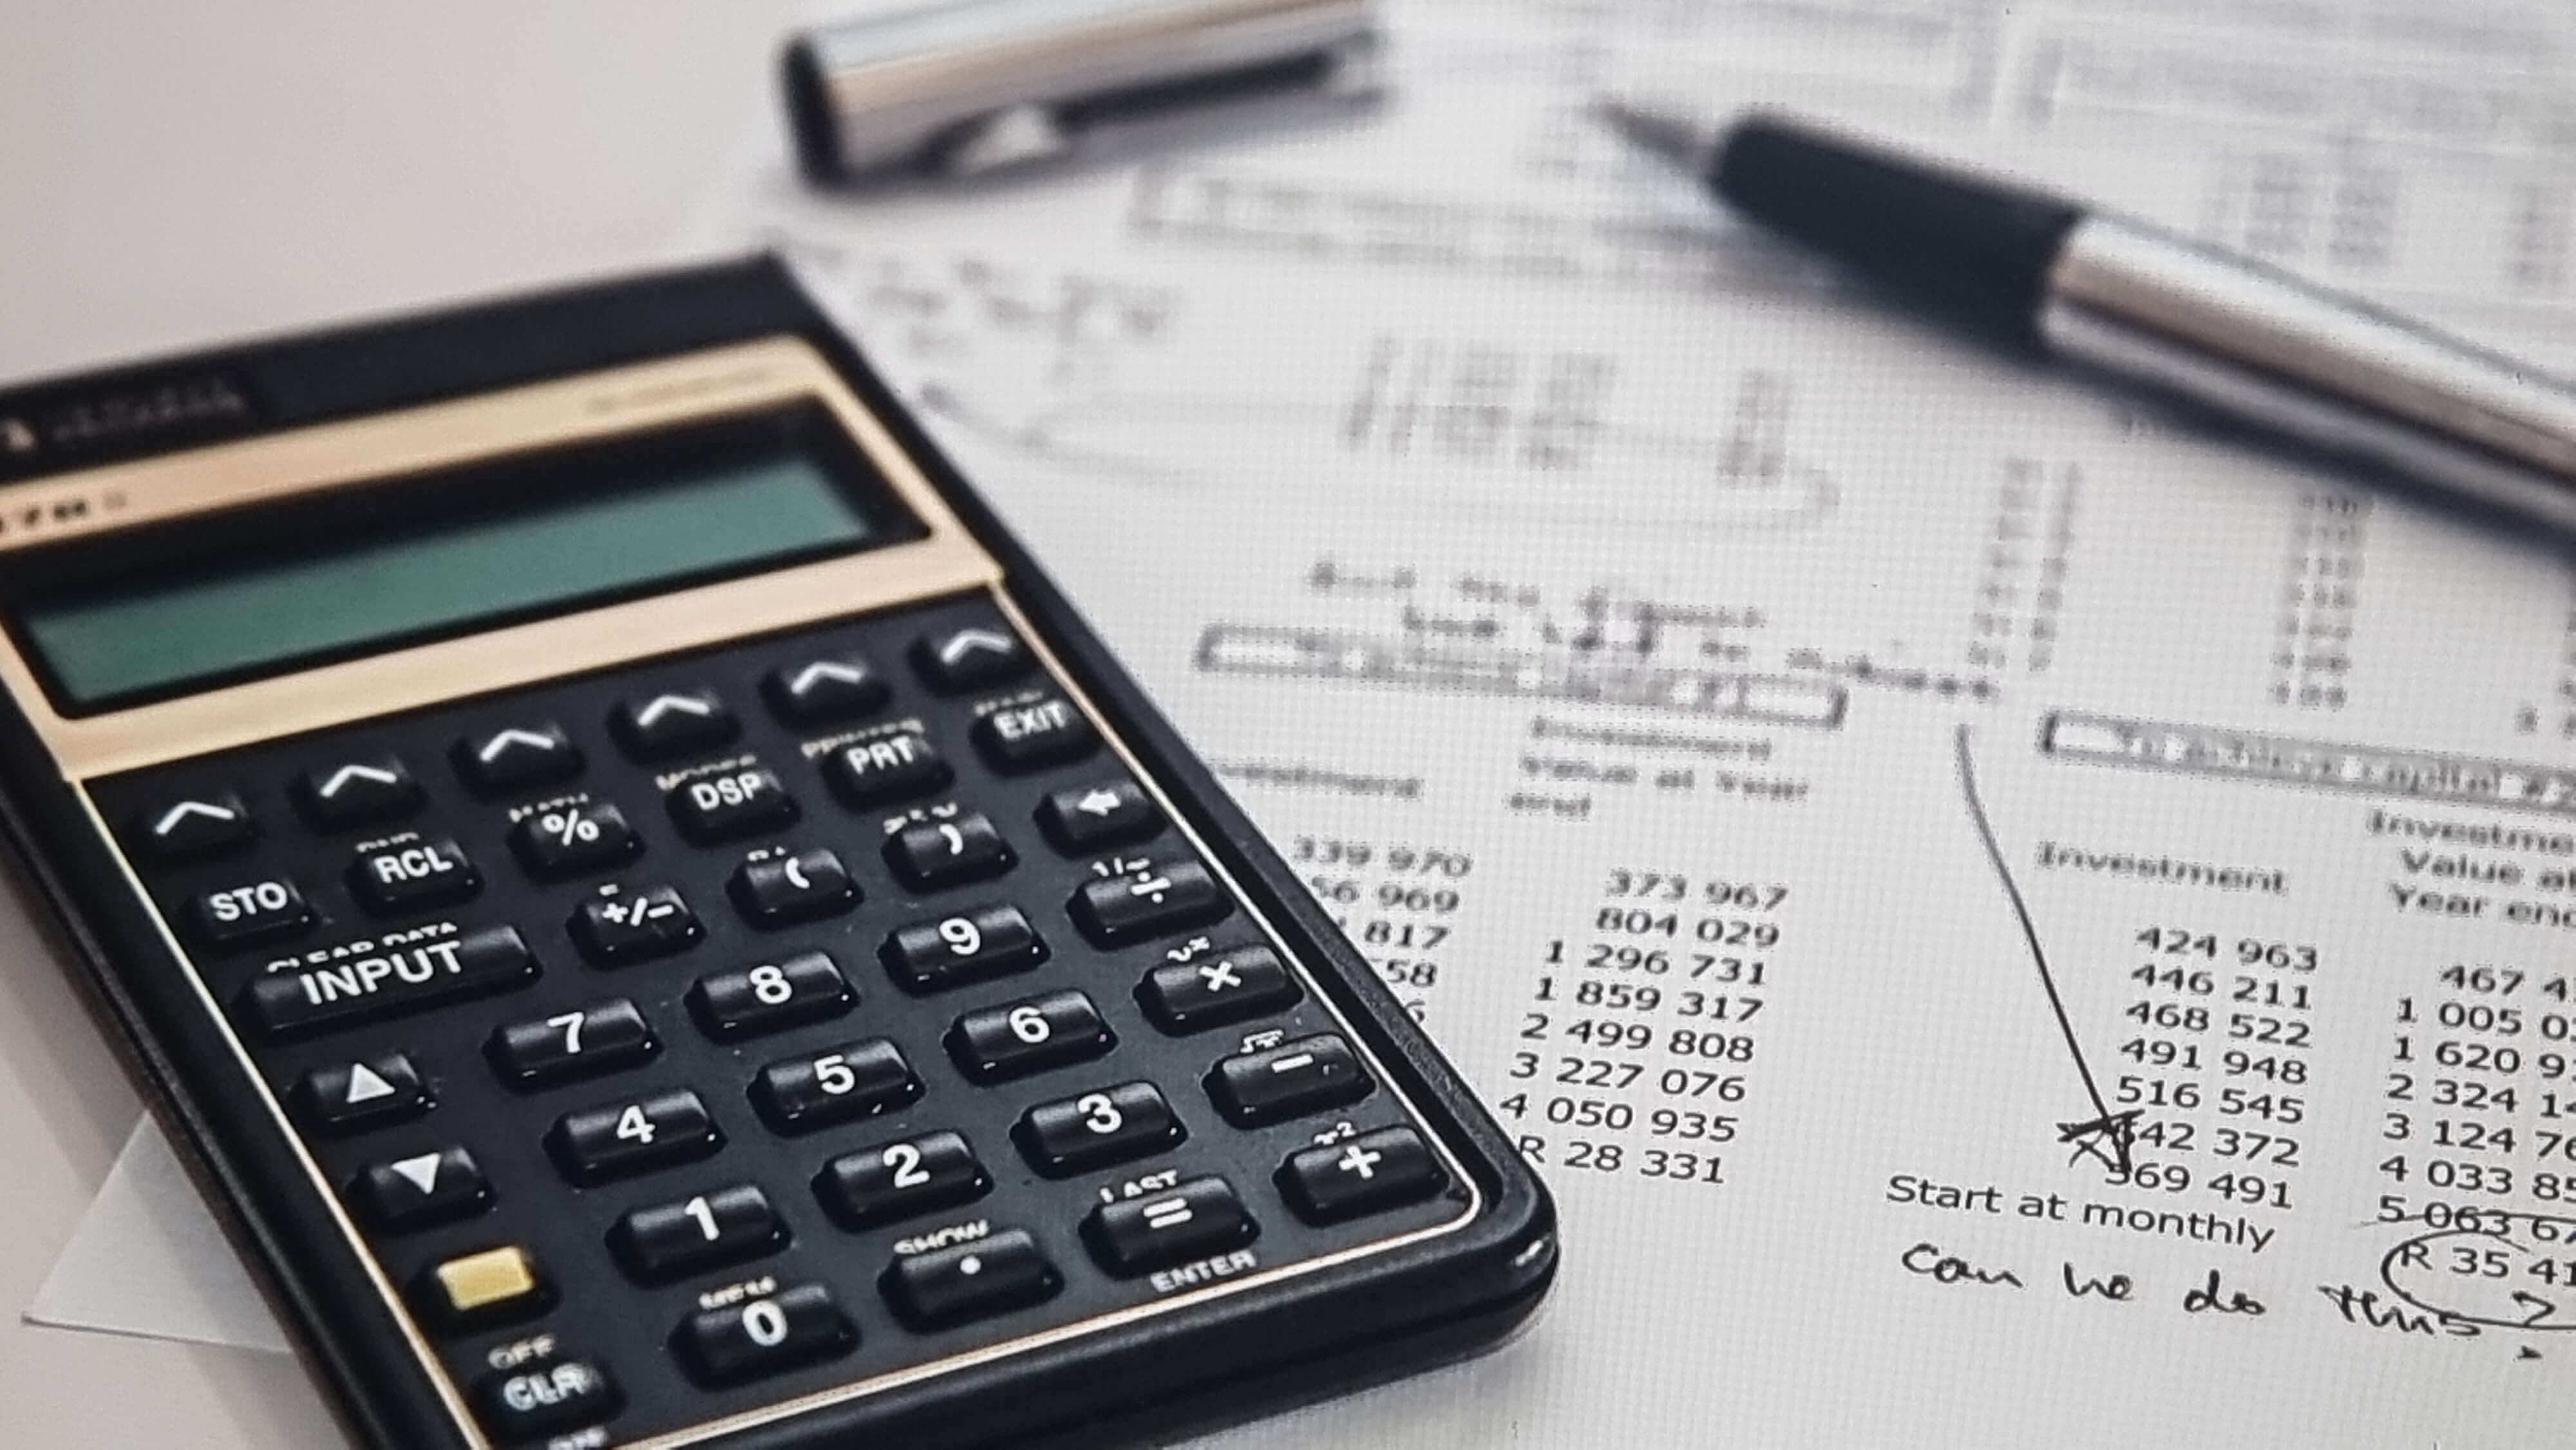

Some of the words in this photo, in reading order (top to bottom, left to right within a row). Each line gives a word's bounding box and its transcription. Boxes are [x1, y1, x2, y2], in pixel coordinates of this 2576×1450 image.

[993, 701, 1066, 739] EXIT
[846, 735, 914, 774] PRT
[690, 773, 762, 811] DSP
[374, 846, 453, 883] RCL
[2401, 847, 2523, 885] Value
[210, 883, 287, 921] STO
[1606, 869, 1688, 901] 373
[1705, 881, 1788, 911] 967
[2389, 880, 2487, 918] Year
[940, 918, 981, 955] 9
[1365, 921, 1450, 950] 817
[1596, 907, 1678, 938] 804
[1696, 918, 1780, 948] 029
[1546, 940, 1564, 964] 1
[1584, 944, 1671, 975] 296
[1689, 954, 1766, 986] 731
[2137, 927, 2217, 959] 424
[2237, 939, 2317, 972] 963
[299, 940, 461, 1004] INPUT
[749, 965, 793, 1004] 8
[1370, 957, 1438, 988] 58
[2131, 964, 2214, 995] 446
[2233, 976, 2312, 1010] 211
[2441, 965, 2524, 995] 467
[2542, 977, 2576, 1003] 4
[1535, 976, 1557, 1001] 1
[1576, 981, 1662, 1012] 859
[1678, 991, 1765, 1023] 317
[2398, 997, 2418, 1023] 1
[2439, 1002, 2522, 1034] 005
[2541, 1015, 2576, 1042] 0
[547, 1012, 585, 1054] 7
[1007, 1006, 1051, 1044] 6
[1520, 1013, 1549, 1040] 2
[1565, 1019, 1653, 1050] 499
[1669, 1029, 1755, 1064] 808
[2126, 1001, 2210, 1031] 468
[2229, 1013, 2312, 1048] 522
[813, 1055, 855, 1095] 5
[1510, 1051, 1540, 1079] 3
[1556, 1057, 1645, 1089] 227
[1660, 1068, 1747, 1102] 076
[2121, 1038, 2202, 1069] 491
[2223, 1051, 2307, 1085] 948
[2394, 1036, 2414, 1060] 1
[2435, 1041, 2521, 1073] 620
[2538, 1053, 2576, 1083] 9
[1077, 1093, 1122, 1134] 3
[2117, 1075, 2201, 1109] 516
[2219, 1088, 2305, 1124] 545
[2387, 1074, 2414, 1100] 2
[2432, 1079, 2519, 1113] 324
[616, 1105, 656, 1143] 4
[1499, 1093, 1528, 1119] 4
[1547, 1096, 1633, 1131] 050
[1650, 1108, 1739, 1143] 935
[2383, 1113, 2410, 1140] 3
[2433, 1120, 2517, 1153] 124
[882, 1144, 931, 1189] 2
[1518, 1135, 1547, 1164] R
[1564, 1140, 1624, 1172] 28
[1640, 1149, 1725, 1184] 331
[2213, 1128, 2300, 1167] 372
[2207, 1171, 2293, 1209] 491
[2380, 1155, 2409, 1182] 4
[2427, 1160, 2513, 1194] 033
[685, 1196, 720, 1241] 1
[1886, 1175, 2003, 1214] Start
[2018, 1193, 2067, 1221] at
[2083, 1200, 2276, 1254] monthly
[2378, 1196, 2407, 1223] 5
[2424, 1201, 2512, 1236] 063
[2532, 1214, 2576, 1244] 6
[1149, 1248, 1257, 1293] ENTER
[2401, 1242, 2432, 1270] R
[2450, 1247, 2510, 1278] 35
[743, 1299, 788, 1346] 0
